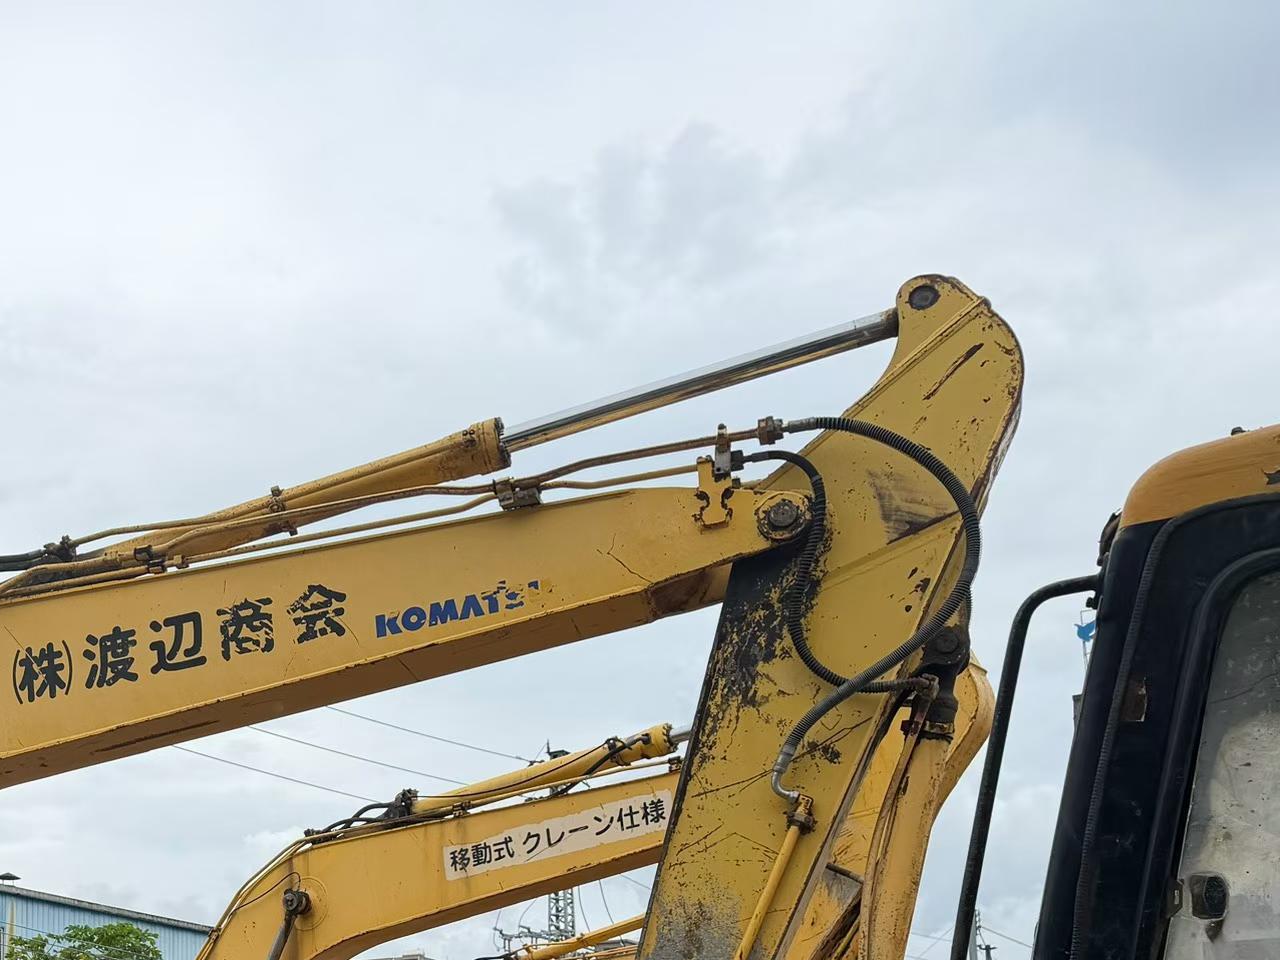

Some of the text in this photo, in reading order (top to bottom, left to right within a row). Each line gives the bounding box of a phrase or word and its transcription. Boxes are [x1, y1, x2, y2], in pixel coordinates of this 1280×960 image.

[375, 580, 539, 638] KOMATS
[450, 799, 666, 872] 移動式クレーン仕様
